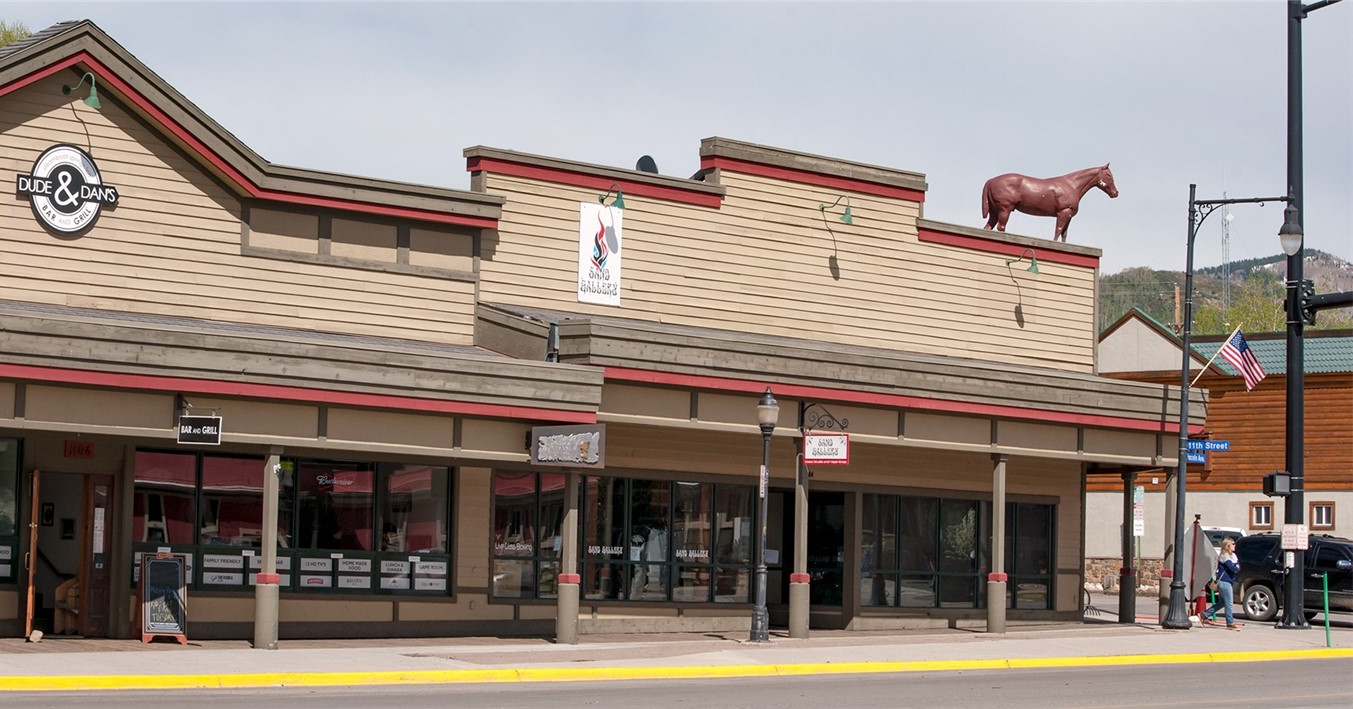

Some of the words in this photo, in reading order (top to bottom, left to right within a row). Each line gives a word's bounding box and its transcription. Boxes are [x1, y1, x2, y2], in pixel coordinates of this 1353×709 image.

[19, 178, 52, 194] DUDE
[54, 171, 79, 206] &
[81, 186, 116, 202] DAN'S
[42, 204, 56, 221] BAR
[74, 208, 91, 225] GRILL
[589, 266, 610, 280] SAND
[580, 279, 618, 297] GALLERY
[181, 425, 192, 434] BAR
[202, 426, 218, 435] GRILL
